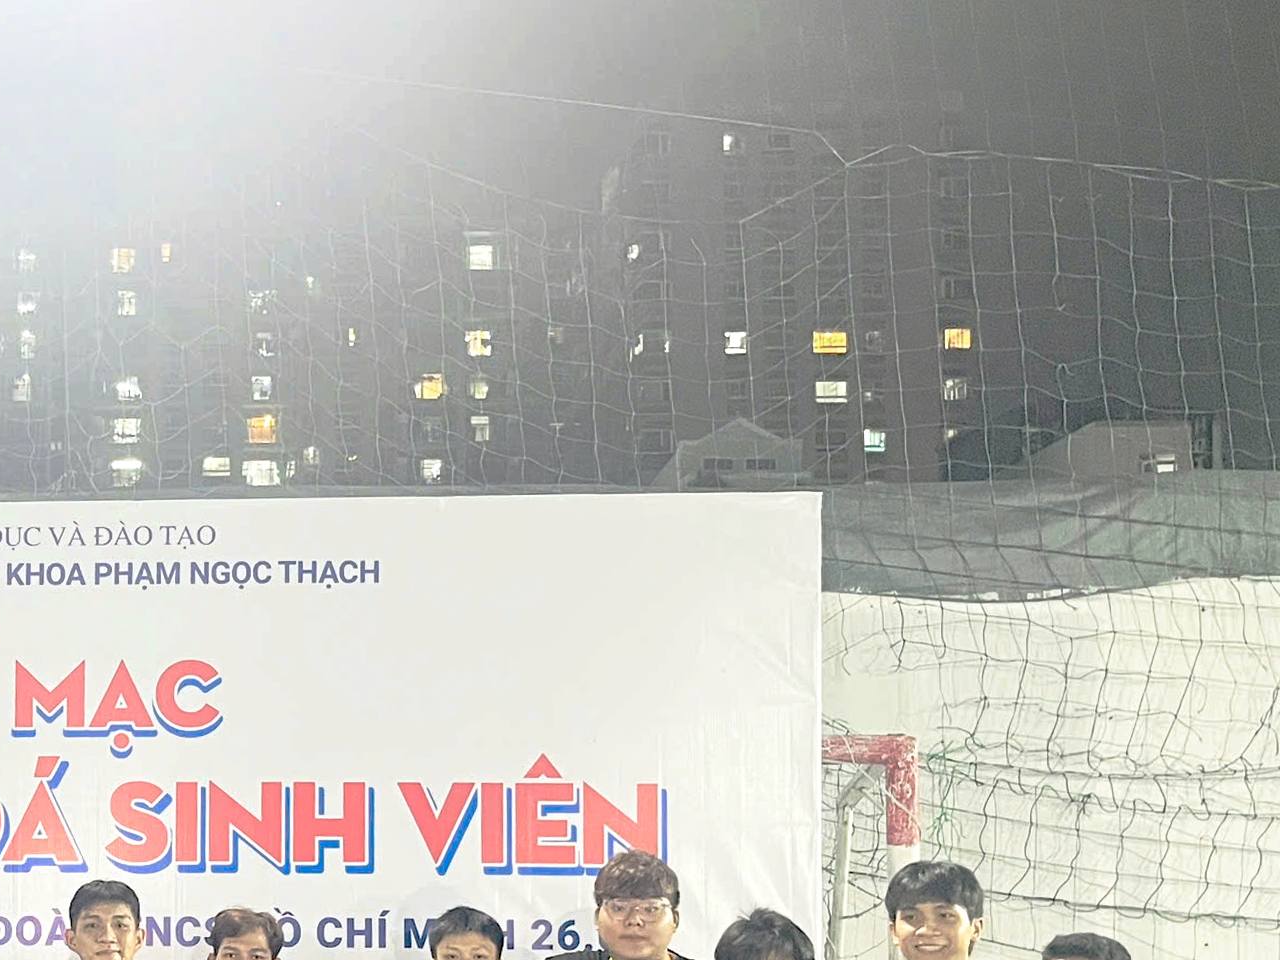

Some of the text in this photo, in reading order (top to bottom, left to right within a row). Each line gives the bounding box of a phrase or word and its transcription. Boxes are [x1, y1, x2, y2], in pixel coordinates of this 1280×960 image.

[48, 521, 86, 546] VÀ
[94, 521, 152, 546] ĐÀO
[159, 525, 216, 549] TẠO
[7, 562, 86, 586] KHOA
[94, 562, 180, 590] PHẠM
[190, 561, 271, 589] NGỌC
[278, 560, 380, 589] THẠCH
[11, 659, 224, 759] MẠC
[105, 780, 375, 875] SINH
[397, 753, 667, 875] VIÊN
[317, 910, 390, 949] CHÍ
